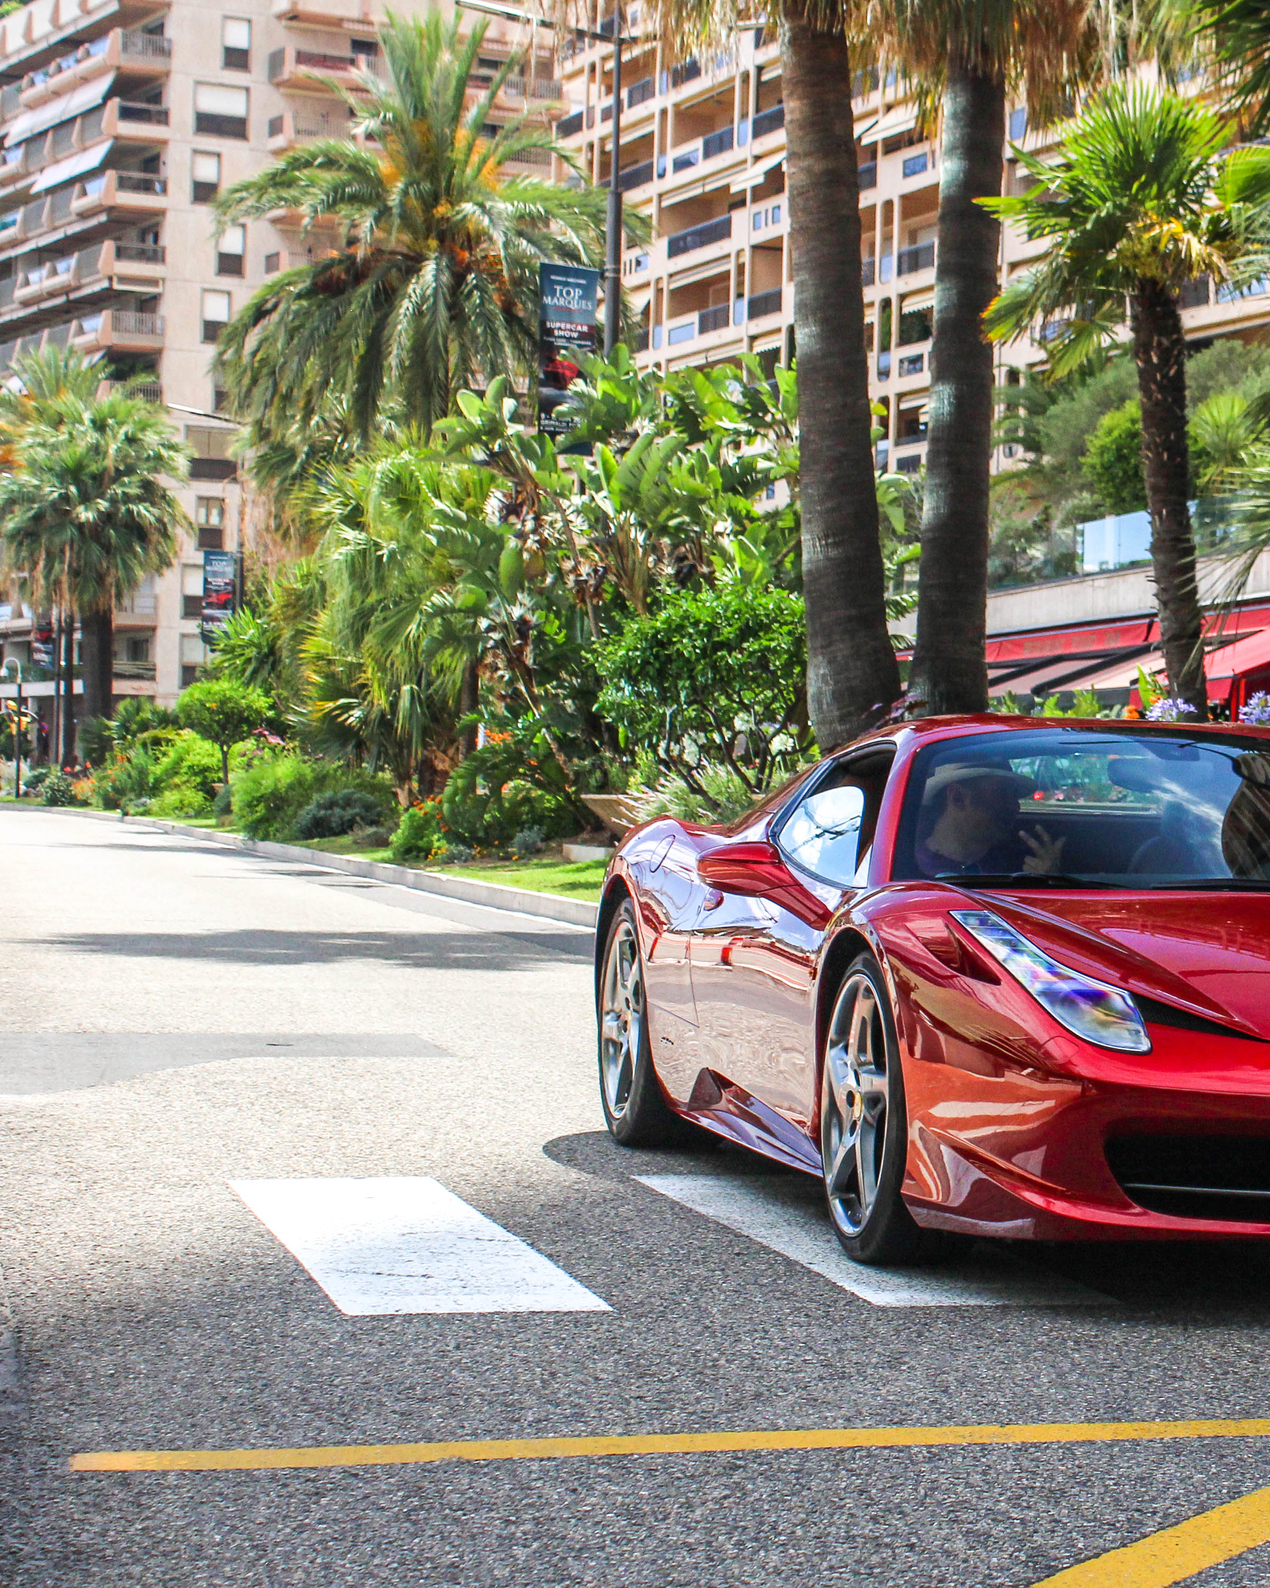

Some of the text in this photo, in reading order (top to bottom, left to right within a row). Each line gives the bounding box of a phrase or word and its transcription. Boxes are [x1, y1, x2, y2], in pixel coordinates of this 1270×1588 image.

[553, 284, 583, 300] TOP
[542, 295, 592, 311] MARQUES
[546, 320, 589, 333] SUPERCAR
[553, 329, 579, 338] SHOW
